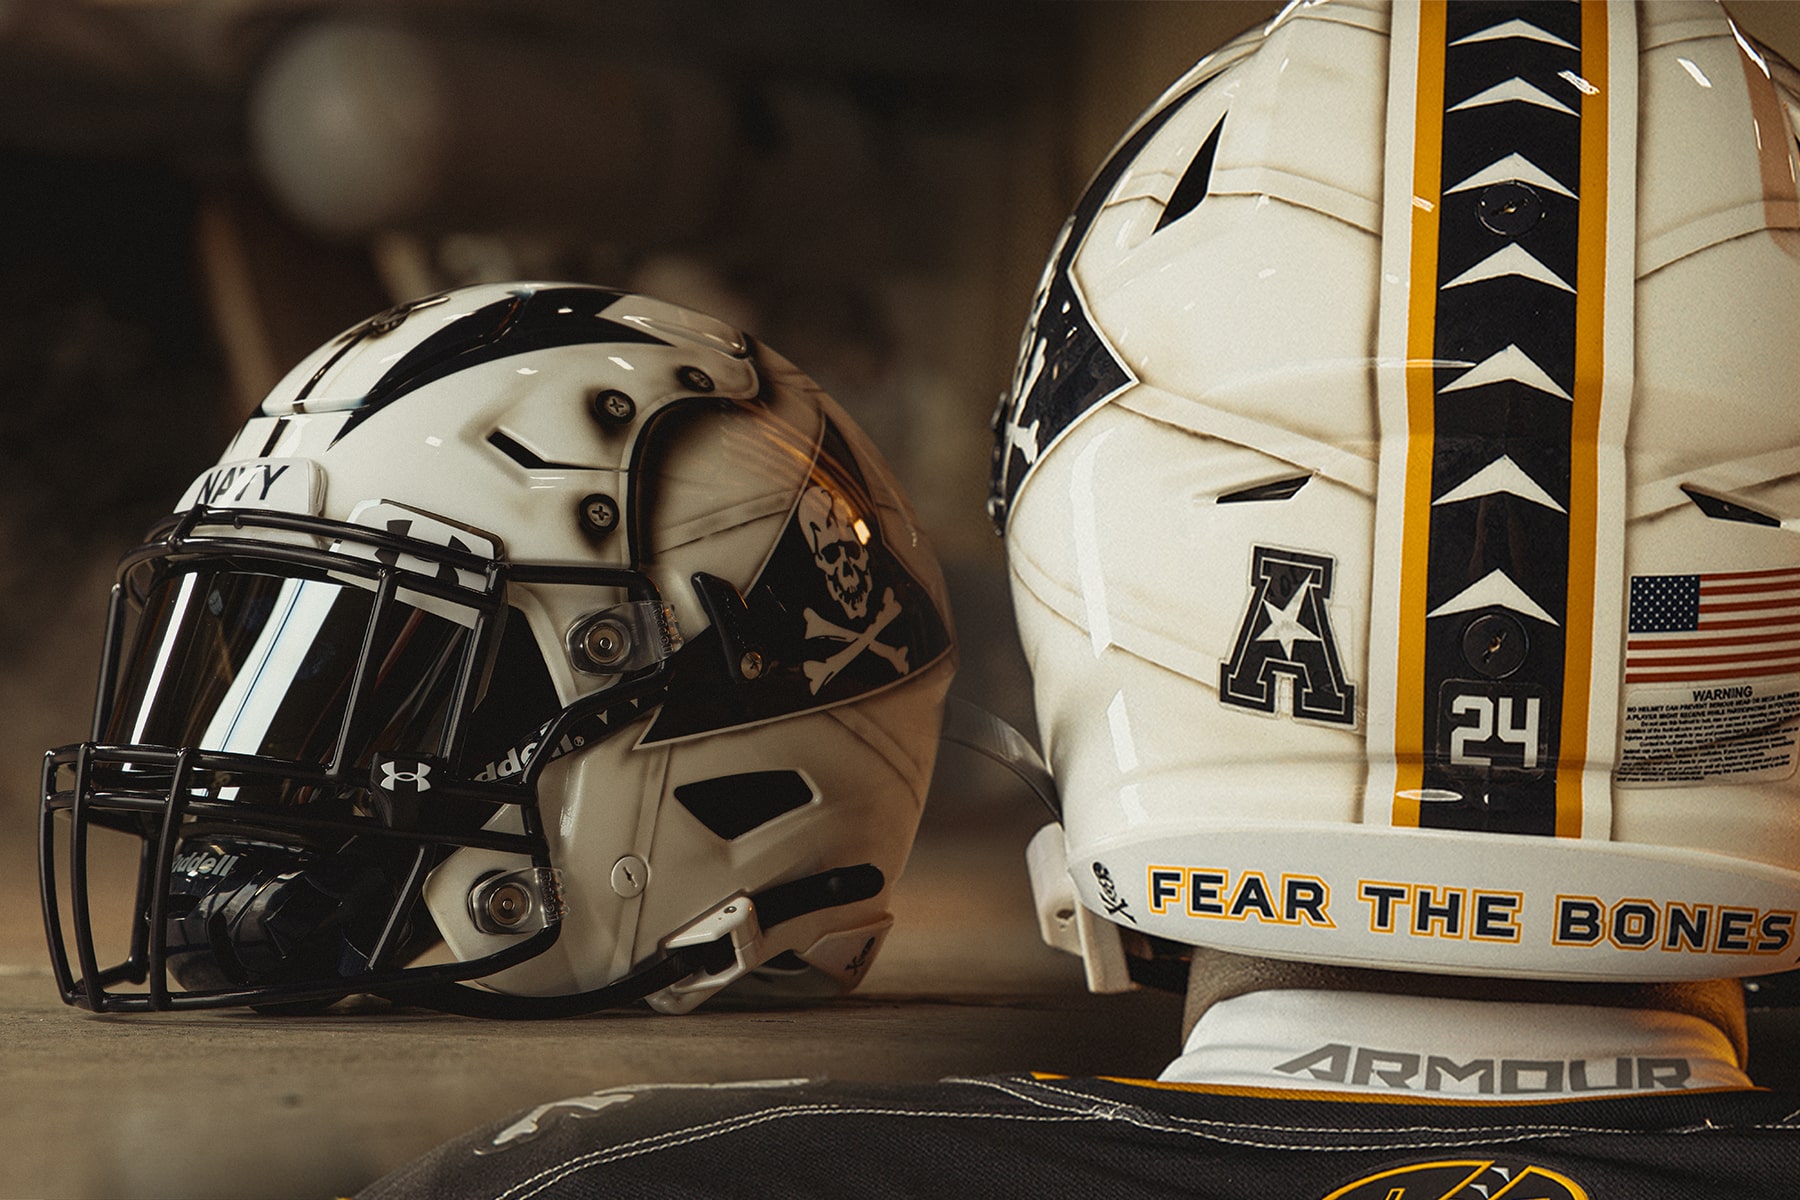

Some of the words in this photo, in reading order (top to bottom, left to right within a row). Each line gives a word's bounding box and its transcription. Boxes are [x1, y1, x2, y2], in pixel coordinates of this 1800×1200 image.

[1693, 686, 1753, 702] WARNING
[1450, 694, 1541, 768] 24
[1148, 865, 1336, 929] FEAR
[1357, 879, 1525, 944] THE
[1551, 894, 1799, 956] BONES
[1274, 1042, 1692, 1095] ARMOUR
